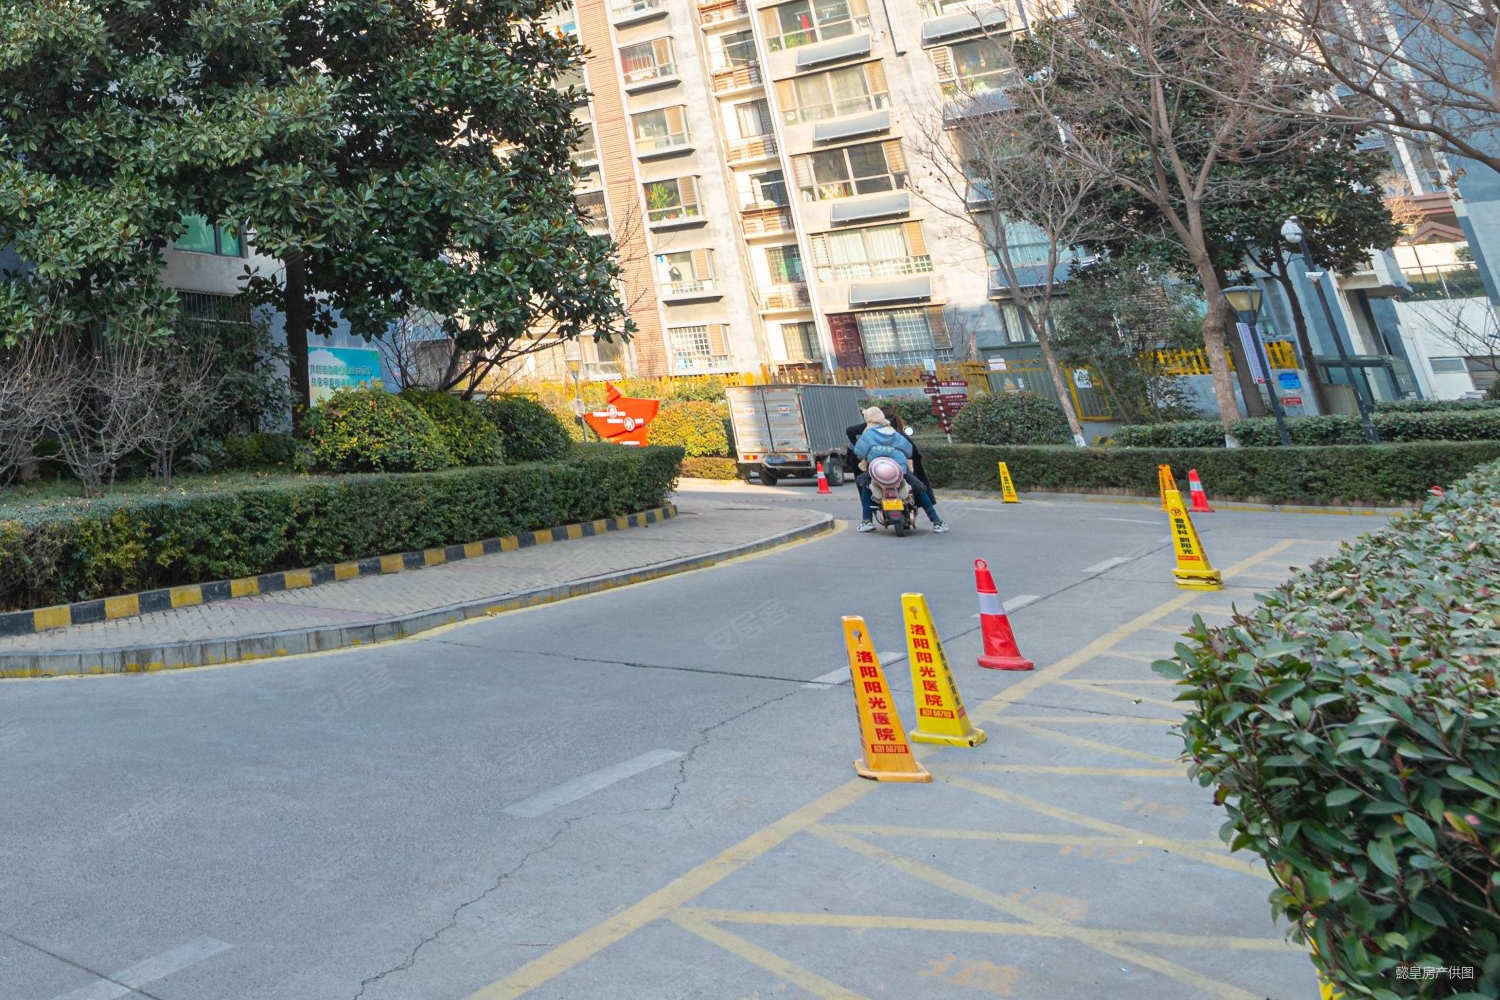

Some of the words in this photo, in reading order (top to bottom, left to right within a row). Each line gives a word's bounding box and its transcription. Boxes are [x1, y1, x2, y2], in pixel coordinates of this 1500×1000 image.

[855, 650, 896, 742] 洛阳阳光医院
[910, 624, 943, 707] 洛阳阳光医院
